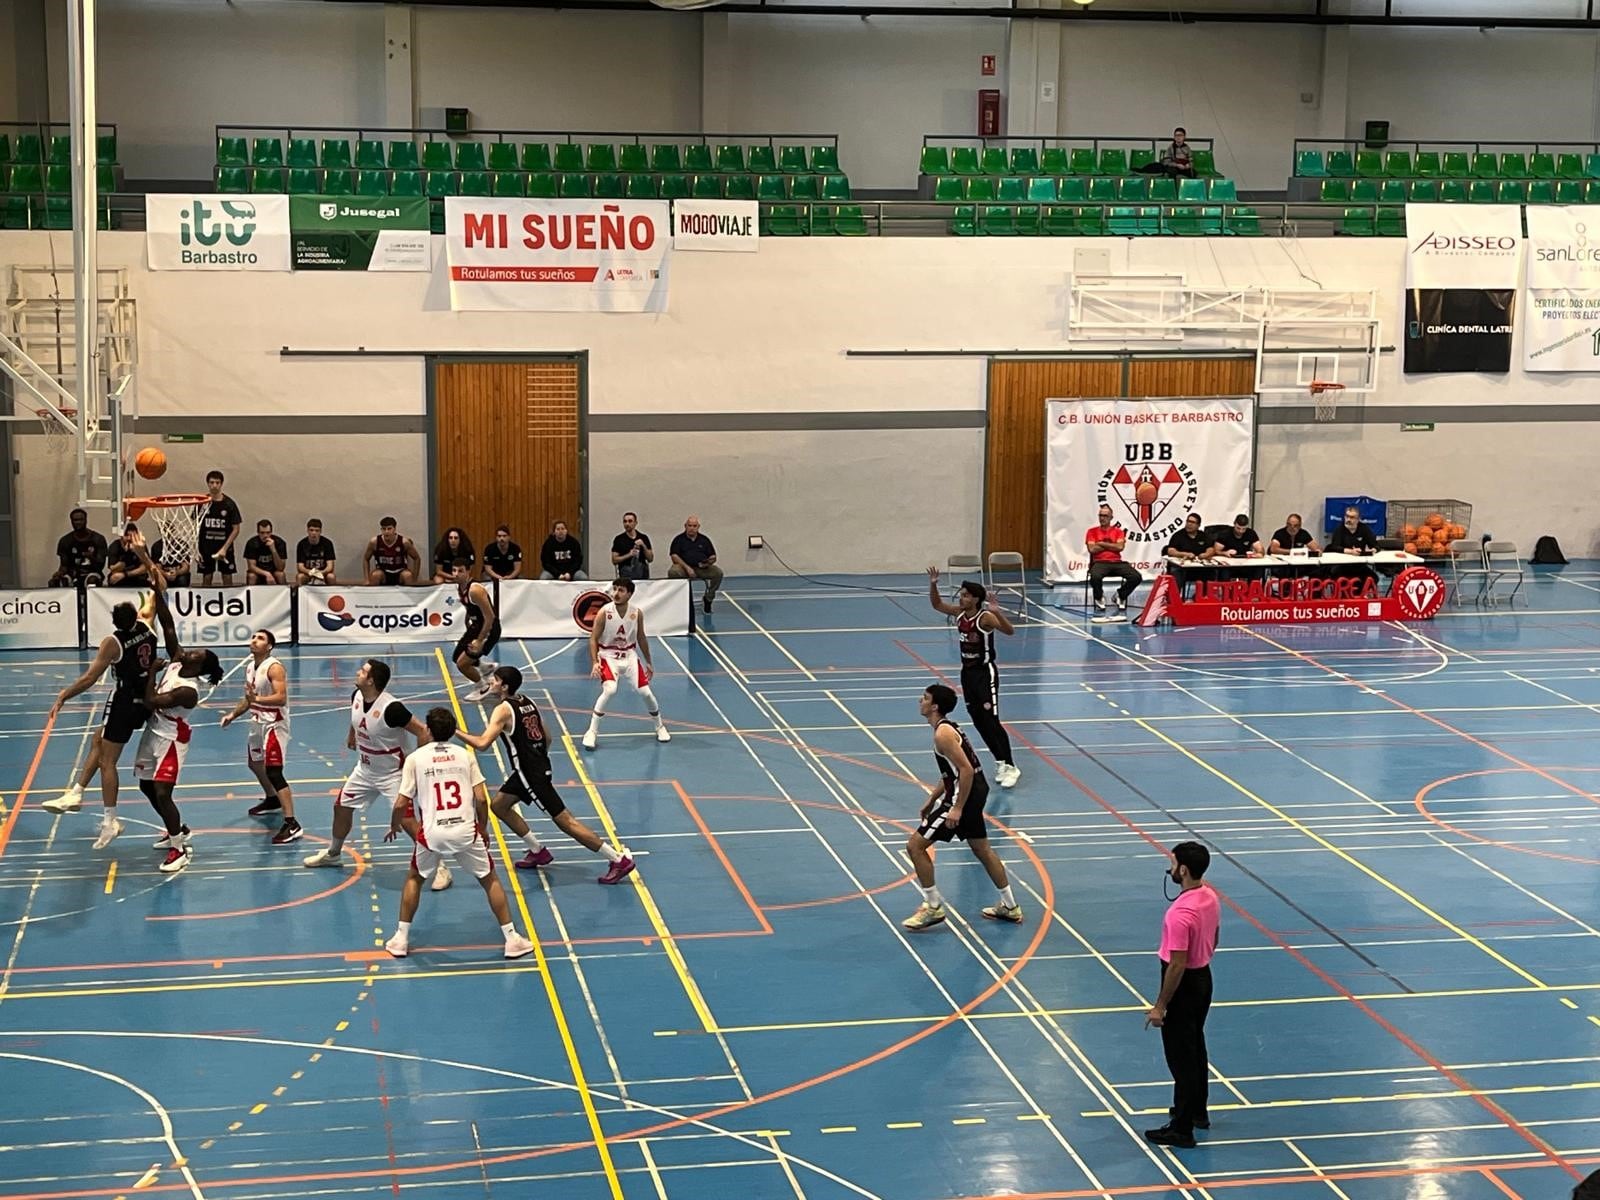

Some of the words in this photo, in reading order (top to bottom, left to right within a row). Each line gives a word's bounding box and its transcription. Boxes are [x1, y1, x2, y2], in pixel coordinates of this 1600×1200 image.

[340, 206, 400, 219] Jusegal
[463, 213, 508, 249] MI
[522, 205, 655, 251] SUEÑO
[681, 214, 752, 237] MODOVIAJE
[1412, 232, 1516, 254] ADISSEO
[181, 250, 258, 265] Barbastro
[461, 267, 518, 280] Rotulamos
[520, 269, 537, 280] tus
[538, 269, 576, 281] sueños
[1542, 310, 1581, 319] PROYECTOS
[1459, 325, 1488, 333] DENTAL
[1058, 414, 1080, 424] C.B.
[1084, 411, 1121, 424] UNIÓN
[1124, 413, 1167, 425] BASKET
[1171, 411, 1244, 423] BARBASTRO
[1125, 443, 1172, 461] UBB
[1178, 462, 1198, 513] BASKET
[205, 518, 226, 528] UESC
[2, 598, 61, 615] cinca
[175, 589, 252, 617] Vidal
[358, 608, 453, 633] capselos
[1220, 606, 1289, 621] Rotulamos
[1293, 606, 1313, 618] tus
[1315, 604, 1360, 618] sueños
[433, 780, 463, 811] 13
